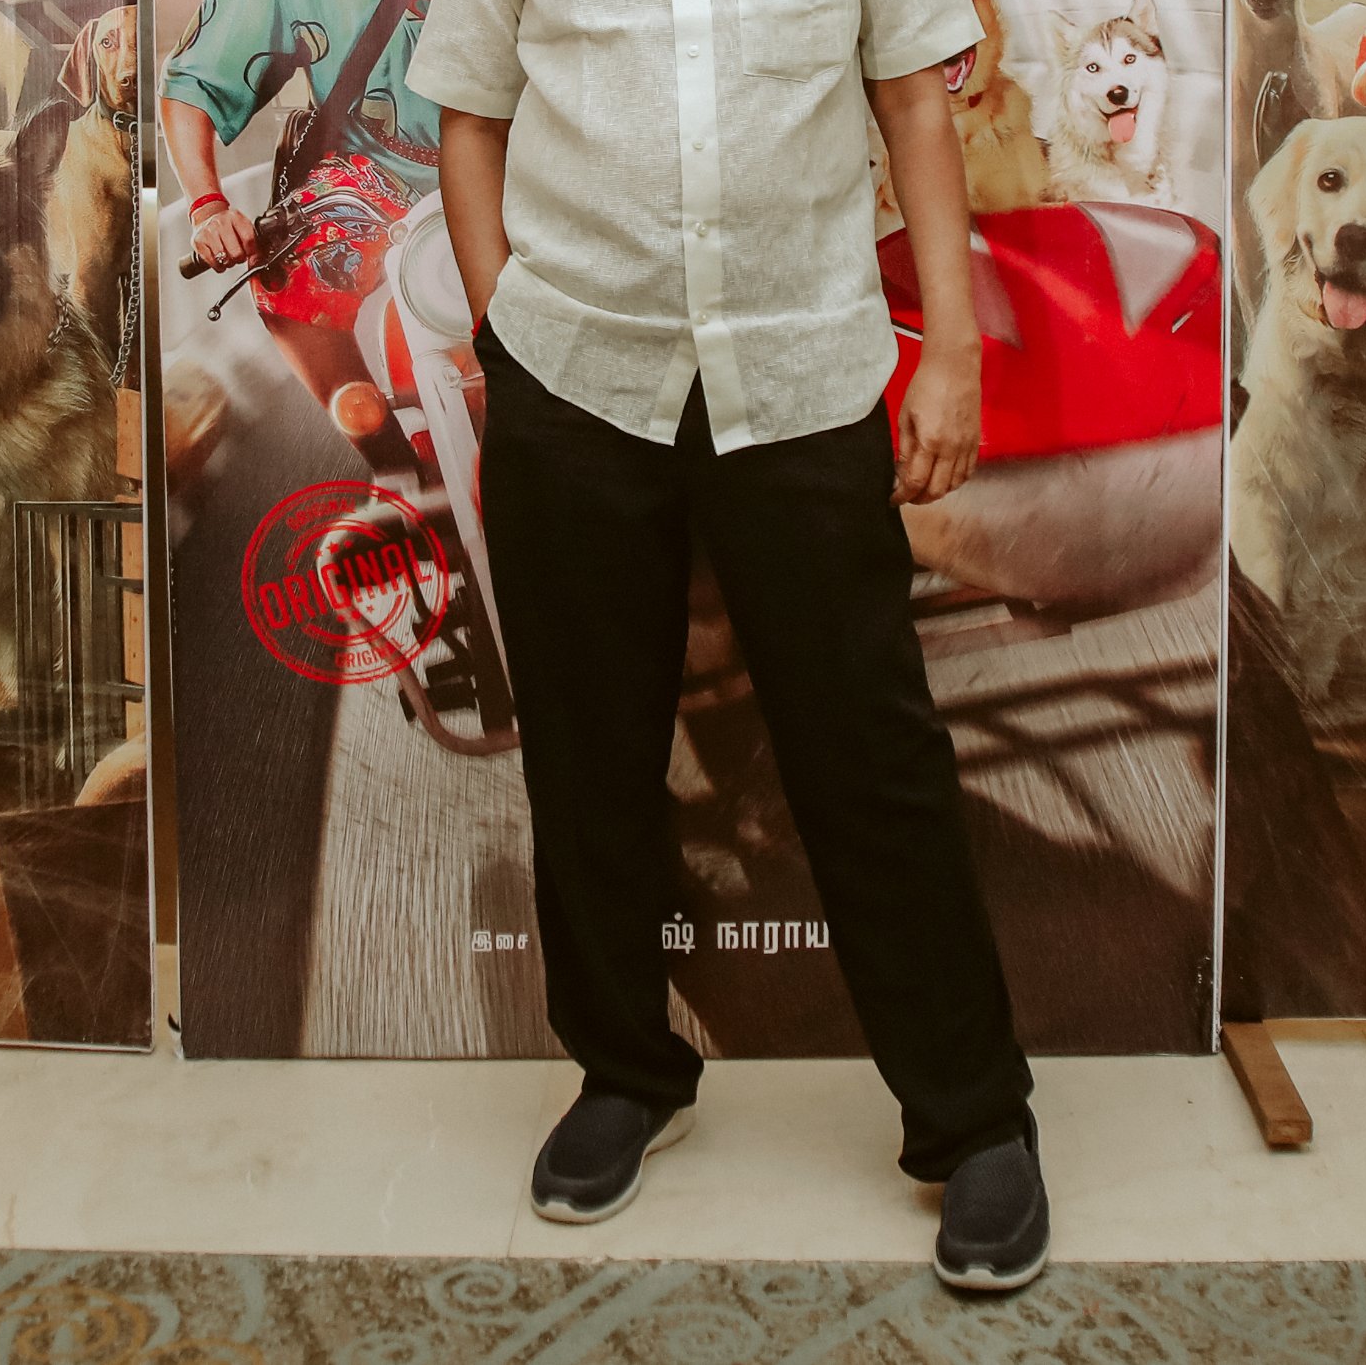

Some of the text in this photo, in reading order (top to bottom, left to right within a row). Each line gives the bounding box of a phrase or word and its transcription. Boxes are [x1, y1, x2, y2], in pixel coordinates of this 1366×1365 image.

[259, 539, 433, 630] ORIGINAL
[471, 930, 529, 952] இசை
[716, 920, 830, 955] நாராய
